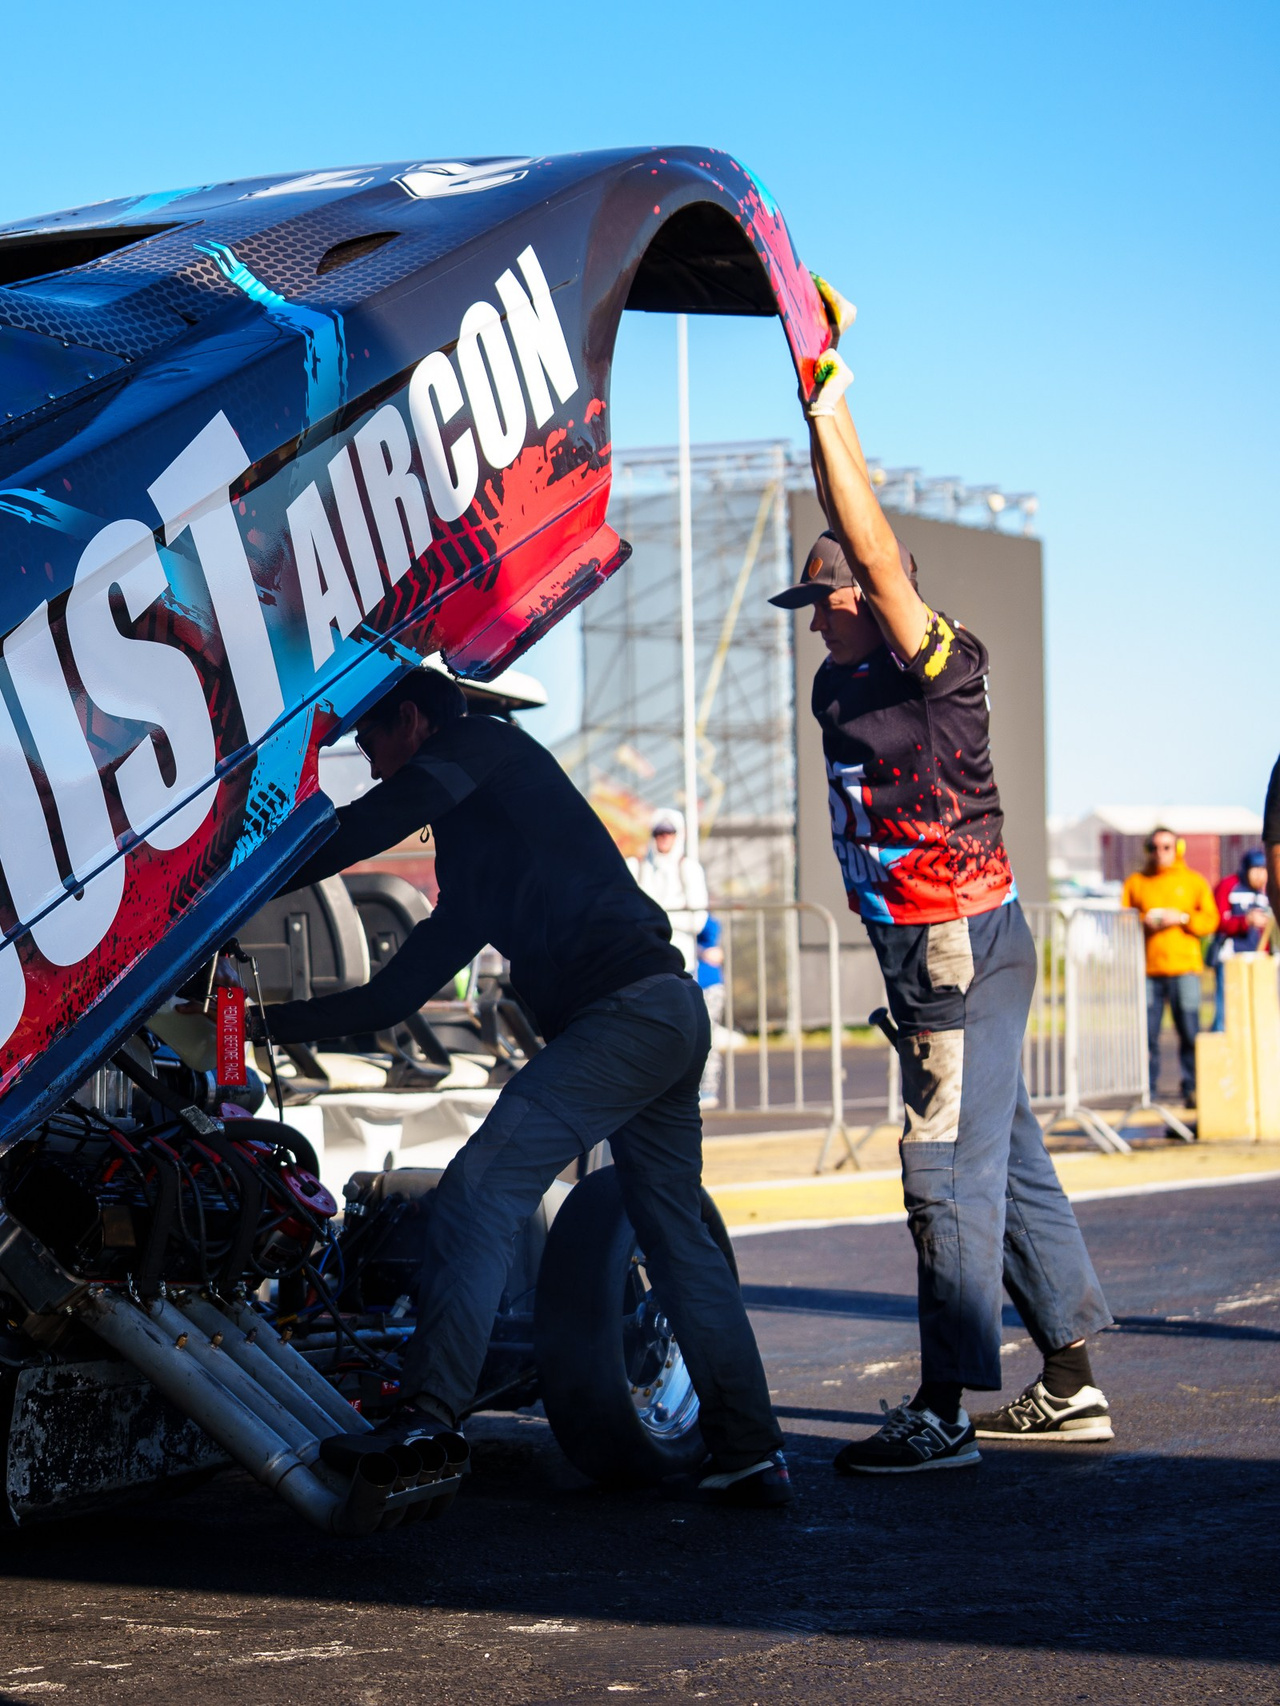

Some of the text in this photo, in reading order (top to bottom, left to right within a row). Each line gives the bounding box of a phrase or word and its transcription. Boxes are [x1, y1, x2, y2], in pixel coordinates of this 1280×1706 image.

[286, 245, 580, 672] AIRCON
[223, 1005, 240, 1081] REMOVE BEFORE RACE
